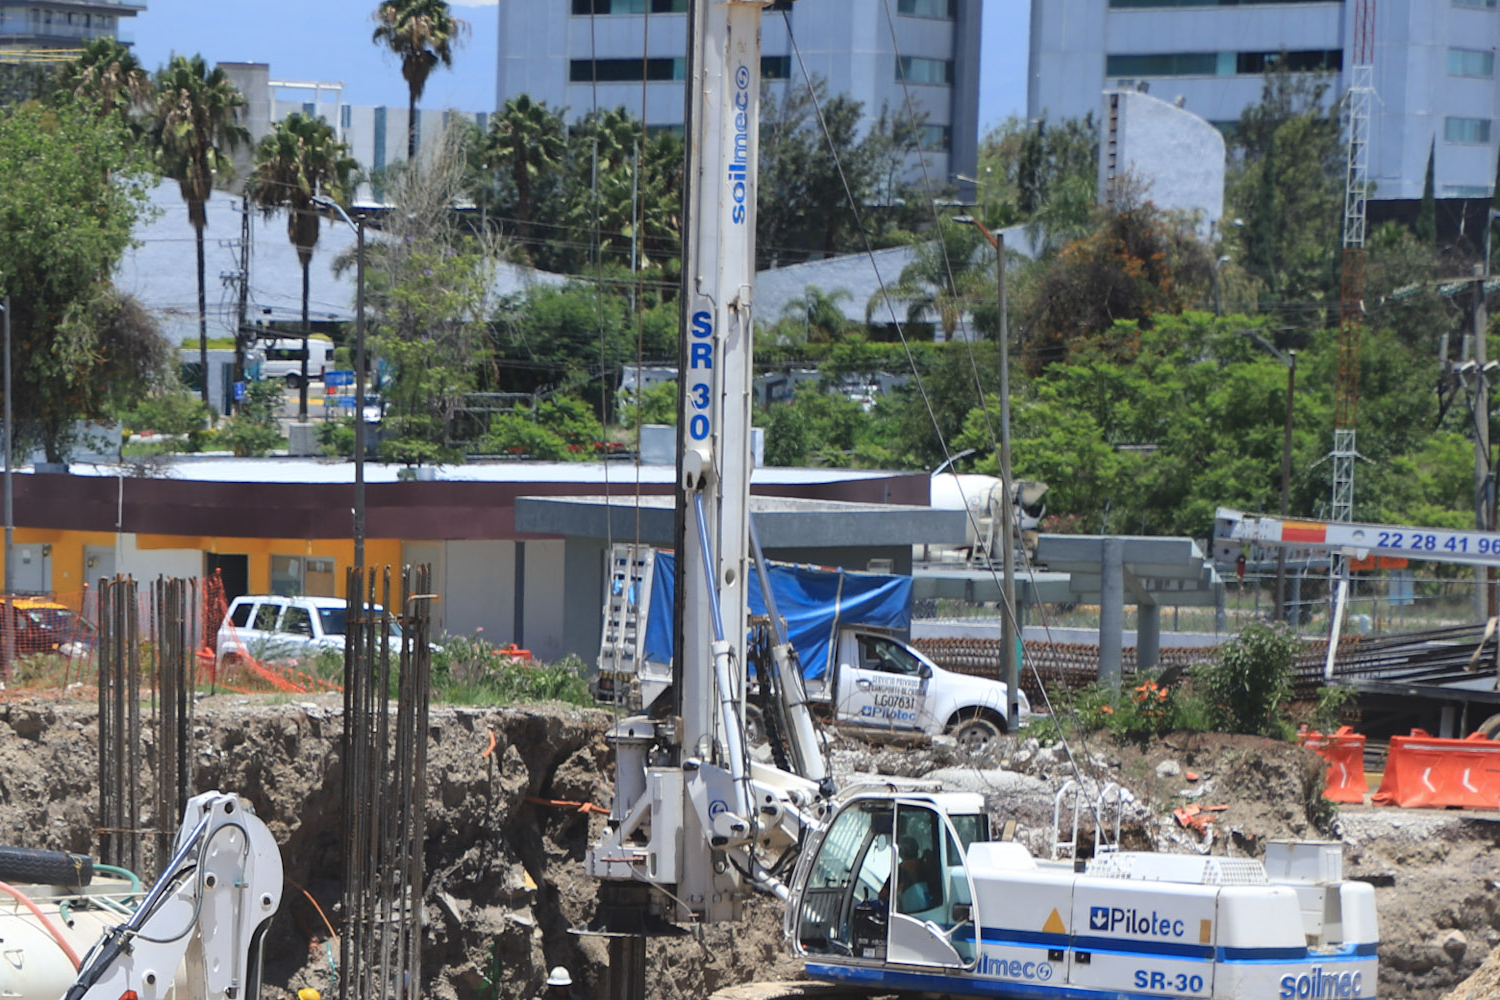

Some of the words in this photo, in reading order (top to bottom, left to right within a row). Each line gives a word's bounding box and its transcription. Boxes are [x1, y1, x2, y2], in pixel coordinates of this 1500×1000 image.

[728, 91, 750, 225] soilmec
[1377, 531, 1404, 549] 22
[1410, 533, 1437, 551] 28
[1443, 536, 1469, 553] 41
[1478, 538, 1500, 555] 96
[872, 706, 917, 721] Pilotec
[874, 693, 915, 710] LG07631
[1110, 907, 1185, 937] Pilotec
[1133, 969, 1204, 993] SR-30
[1279, 965, 1363, 1000] soilmec
